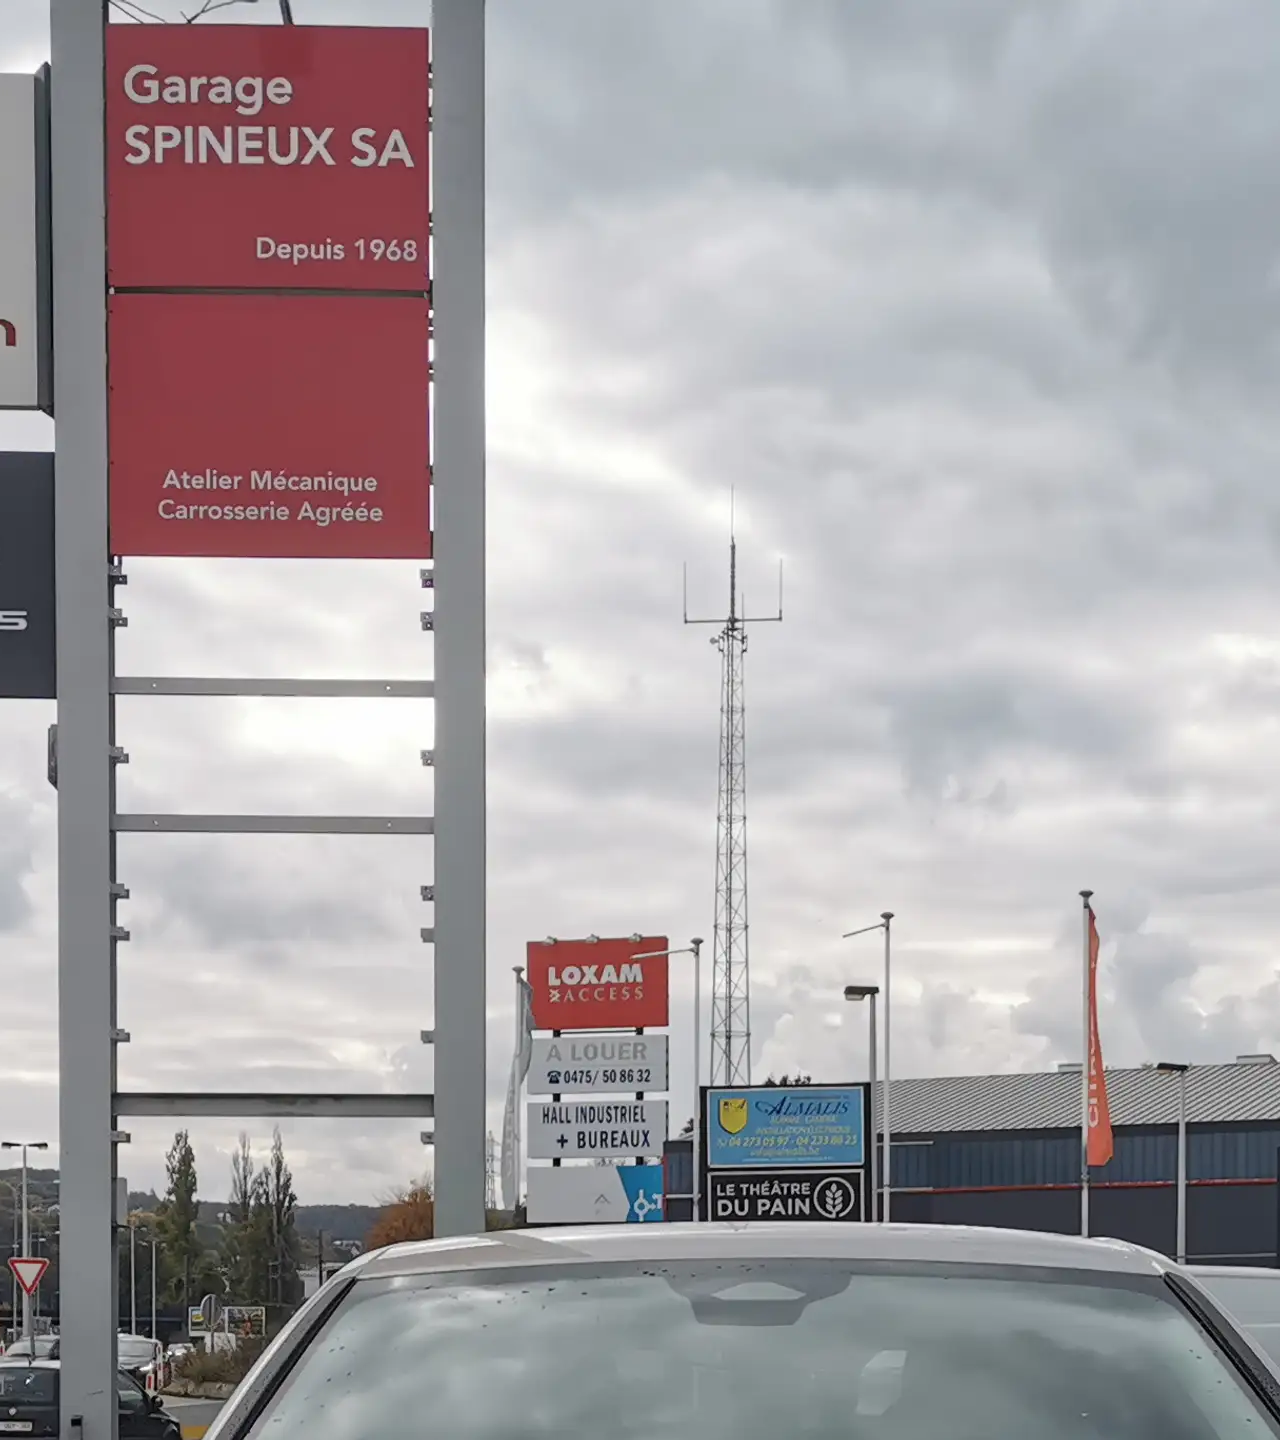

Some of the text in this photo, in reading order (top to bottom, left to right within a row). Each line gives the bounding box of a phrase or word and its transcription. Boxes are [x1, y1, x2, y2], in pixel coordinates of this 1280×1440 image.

[124, 63, 293, 115] Garage
[124, 124, 415, 168] SPINEUX SA
[255, 236, 418, 266] Depuis 1968
[163, 468, 378, 497] Atelier Mécanique
[157, 500, 384, 526] Carrosserie Agréée
[548, 963, 644, 986] LOXAM
[563, 986, 644, 1002] ACCESS
[546, 1042, 648, 1062] A LOUER
[602, 1069, 617, 1083] 50
[620, 1069, 634, 1083] 86
[637, 1069, 651, 1083] 32
[542, 1105, 646, 1124] HALL INDUSTRIEL
[577, 1130, 651, 1149] BUREAUX
[716, 1180, 811, 1196] LE THÉÂTRE
[717, 1198, 811, 1216] DU PAIN
